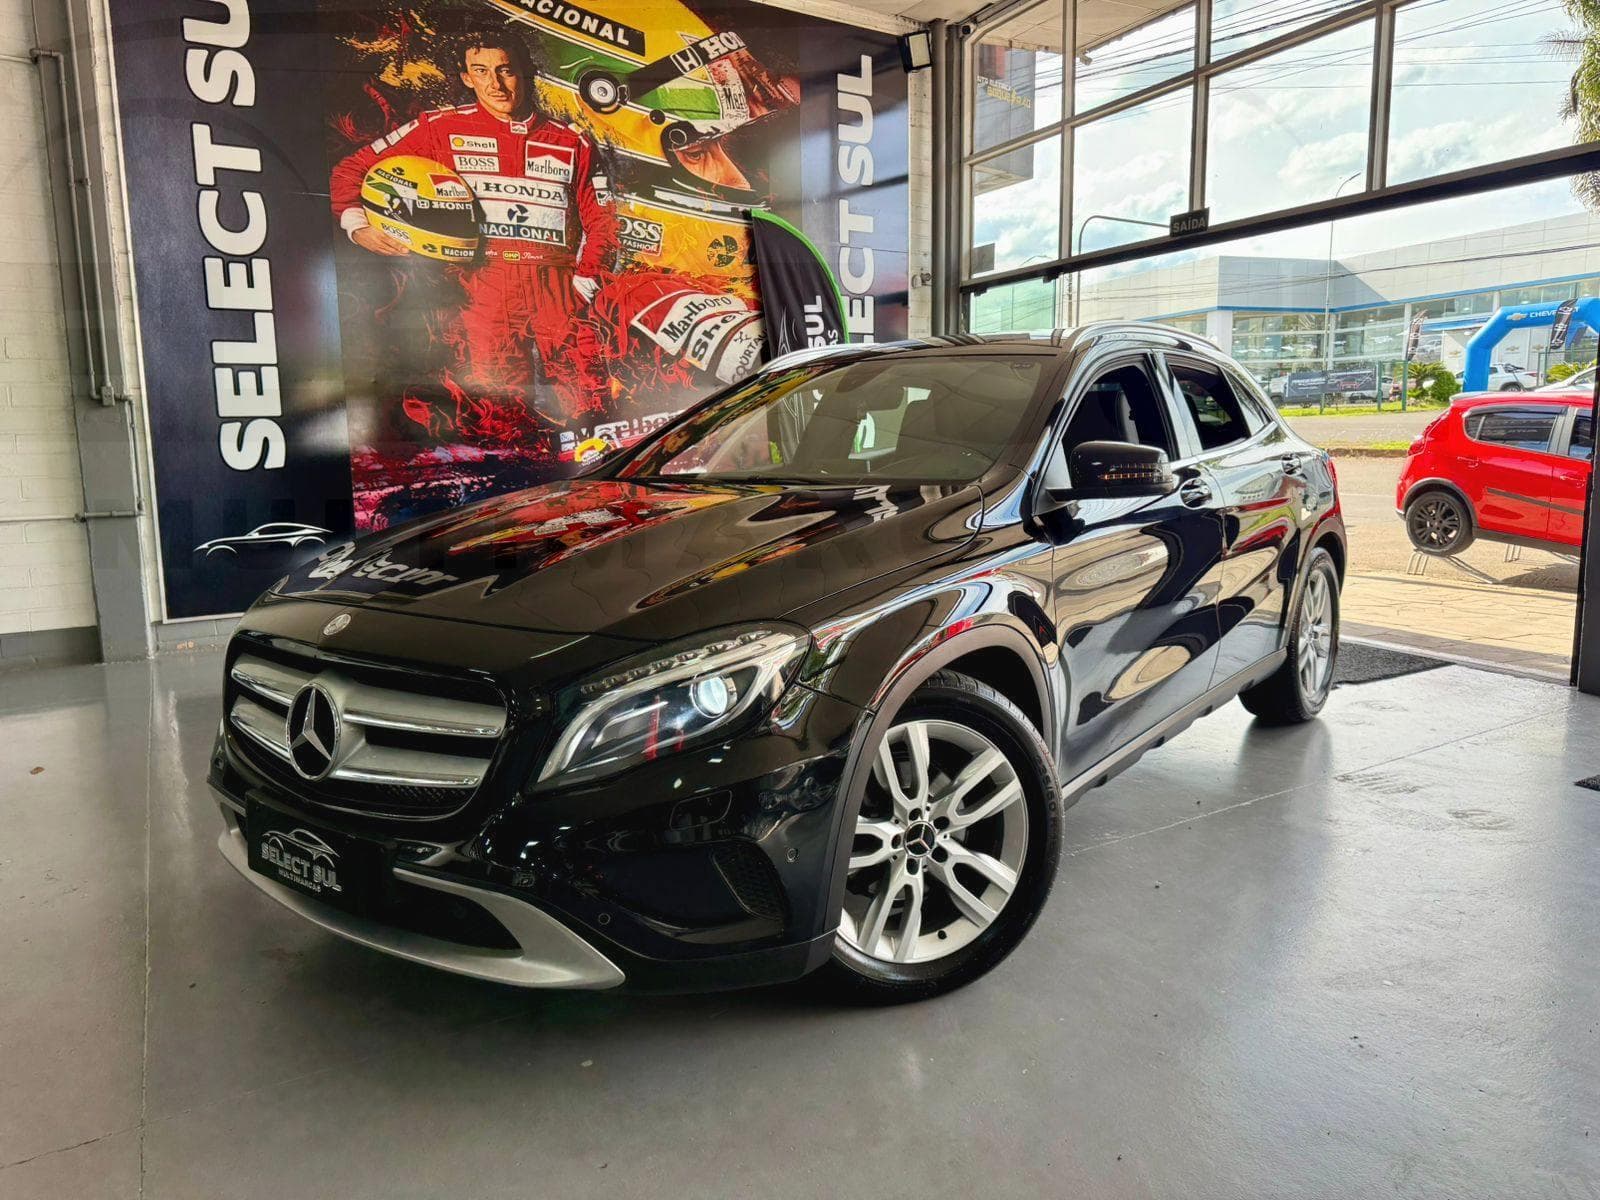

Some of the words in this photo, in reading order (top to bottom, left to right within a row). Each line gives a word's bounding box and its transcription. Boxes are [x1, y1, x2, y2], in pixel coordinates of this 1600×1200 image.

[837, 55, 874, 186] SUL
[466, 140, 496, 149] Shell
[459, 156, 495, 167] BOSS
[526, 159, 571, 178] Marlboro
[376, 169, 415, 188] NACIONAL
[483, 181, 565, 202] HONDA
[1172, 216, 1206, 233] SAÍDA
[192, 123, 286, 471] SELECT
[660, 296, 733, 344] Marlboro
[261, 842, 310, 878] SELECT
[313, 865, 342, 892] SUL
